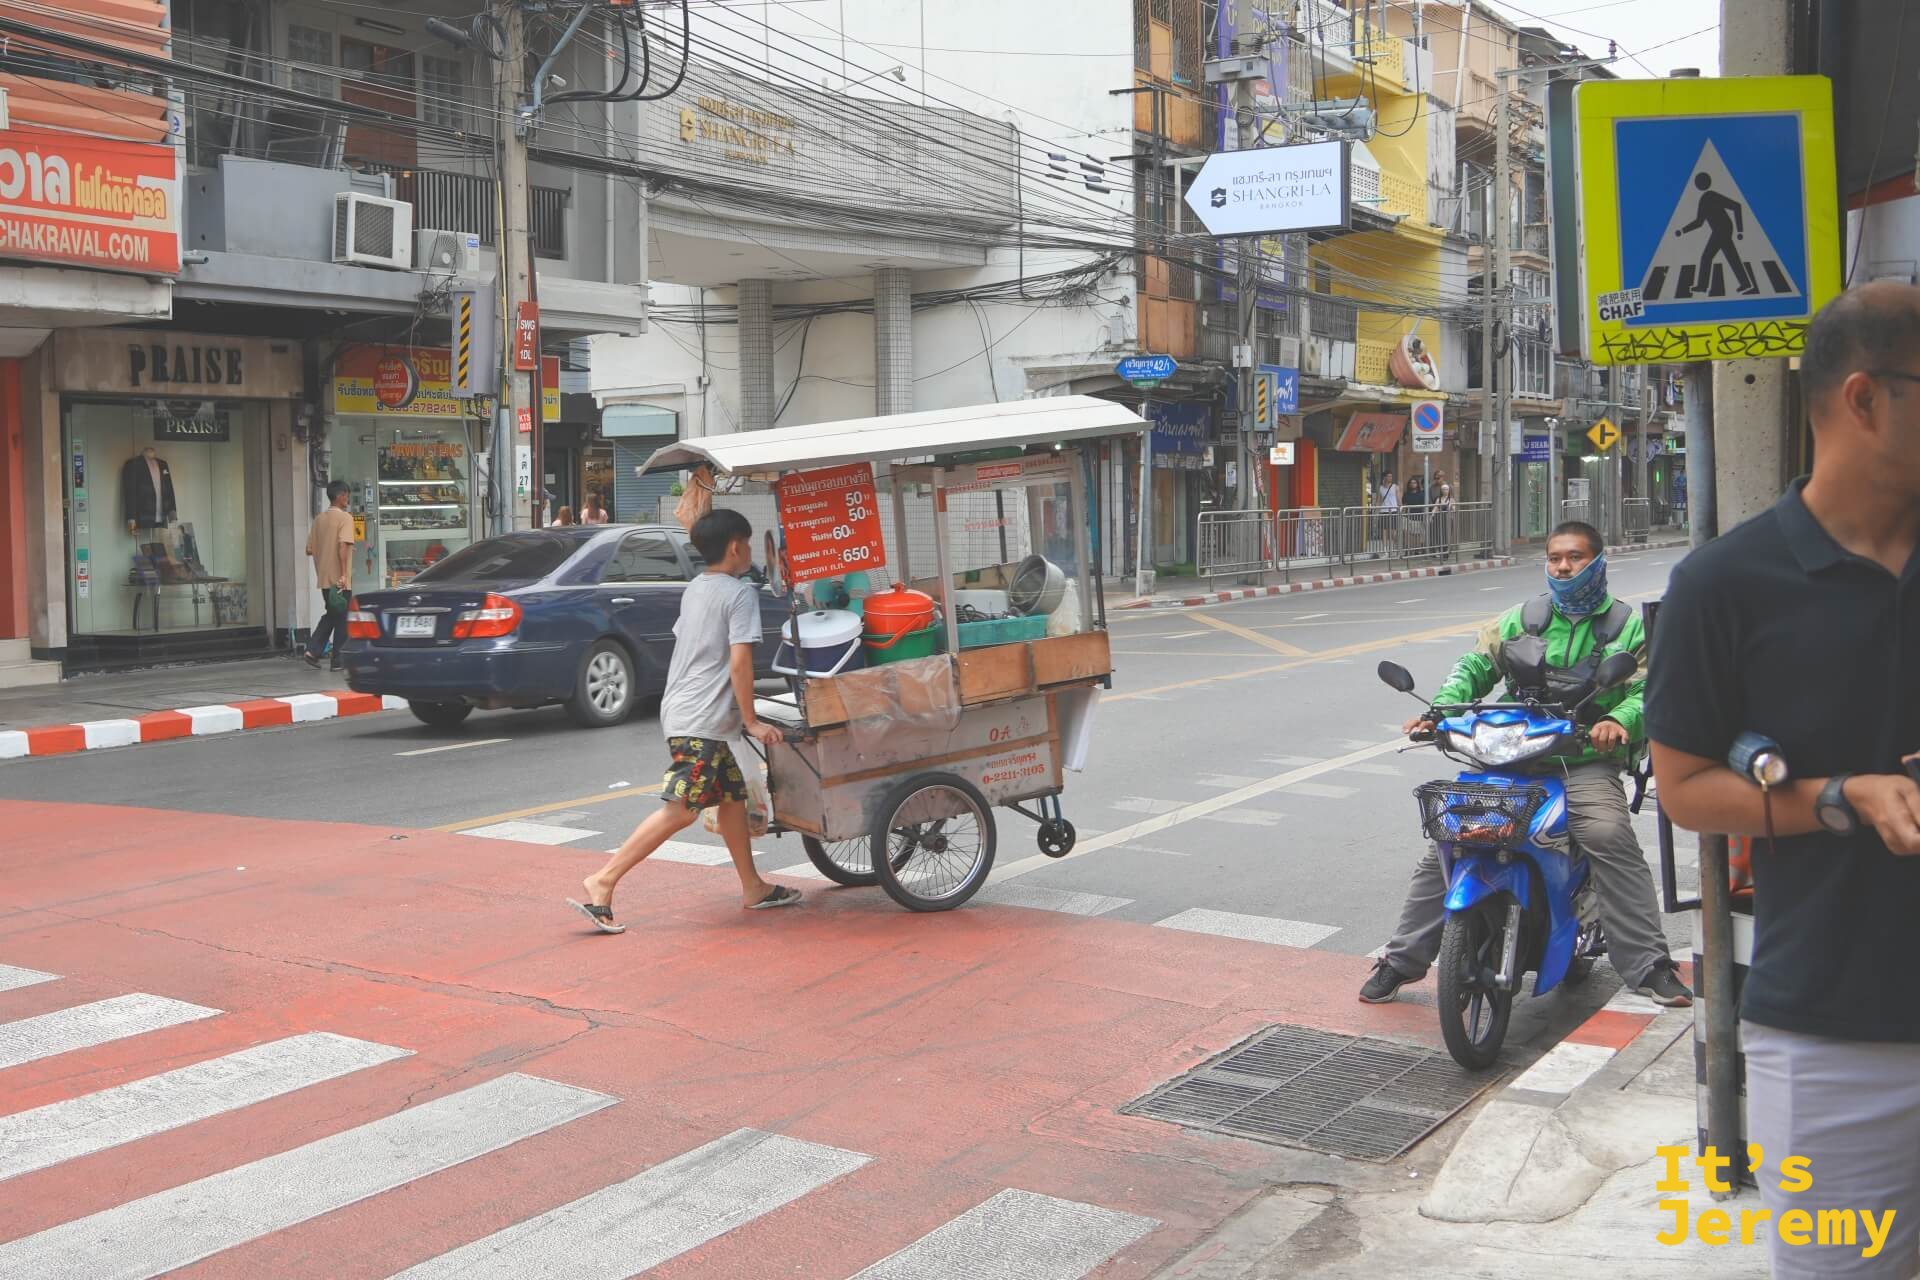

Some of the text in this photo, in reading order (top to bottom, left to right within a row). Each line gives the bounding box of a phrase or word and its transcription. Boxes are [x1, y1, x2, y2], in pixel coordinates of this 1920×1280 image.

[1232, 184, 1331, 203] SHANGRI-LA
[1260, 202, 1303, 210] BANGKOK
[1600, 302, 1643, 321] CHAF
[520, 320, 535, 330] SWG
[523, 331, 532, 341] 14
[128, 344, 243, 387] PRAISE
[1153, 358, 1170, 371] 42/1
[166, 418, 224, 434] PRAISE
[519, 475, 529, 486] 27
[845, 491, 862, 507] 50
[848, 506, 866, 522] 50
[832, 524, 850, 540] 60
